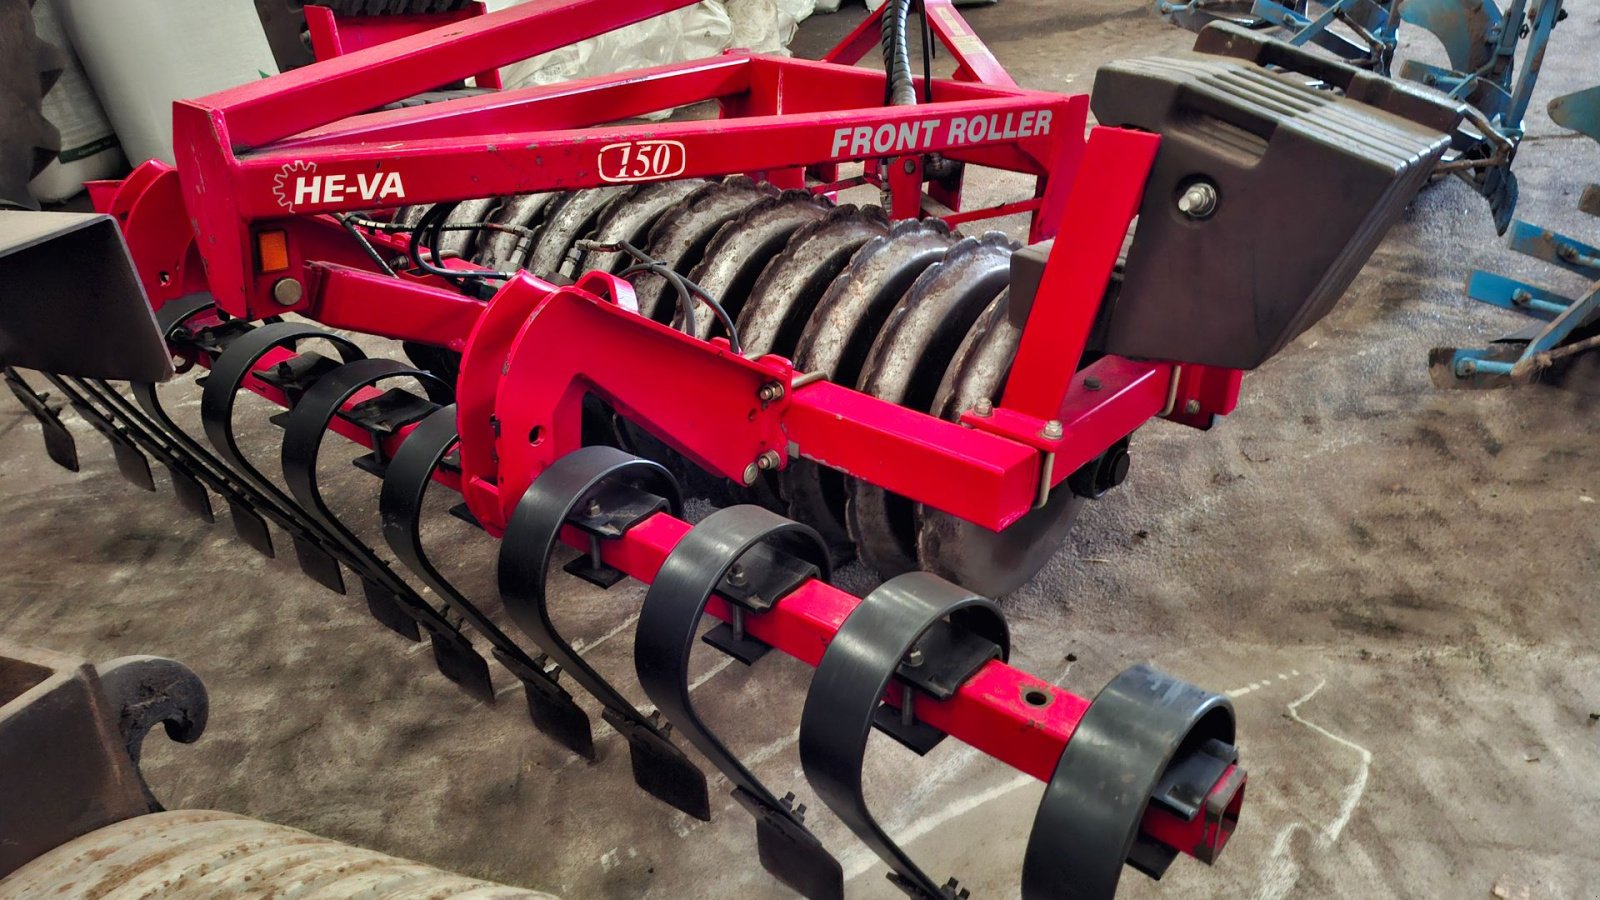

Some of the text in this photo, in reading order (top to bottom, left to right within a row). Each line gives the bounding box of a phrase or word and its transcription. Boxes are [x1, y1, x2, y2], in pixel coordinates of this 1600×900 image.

[831, 109, 1053, 158] FRONT ROLLER
[615, 144, 671, 178] 150
[294, 172, 405, 205] HE-VA
